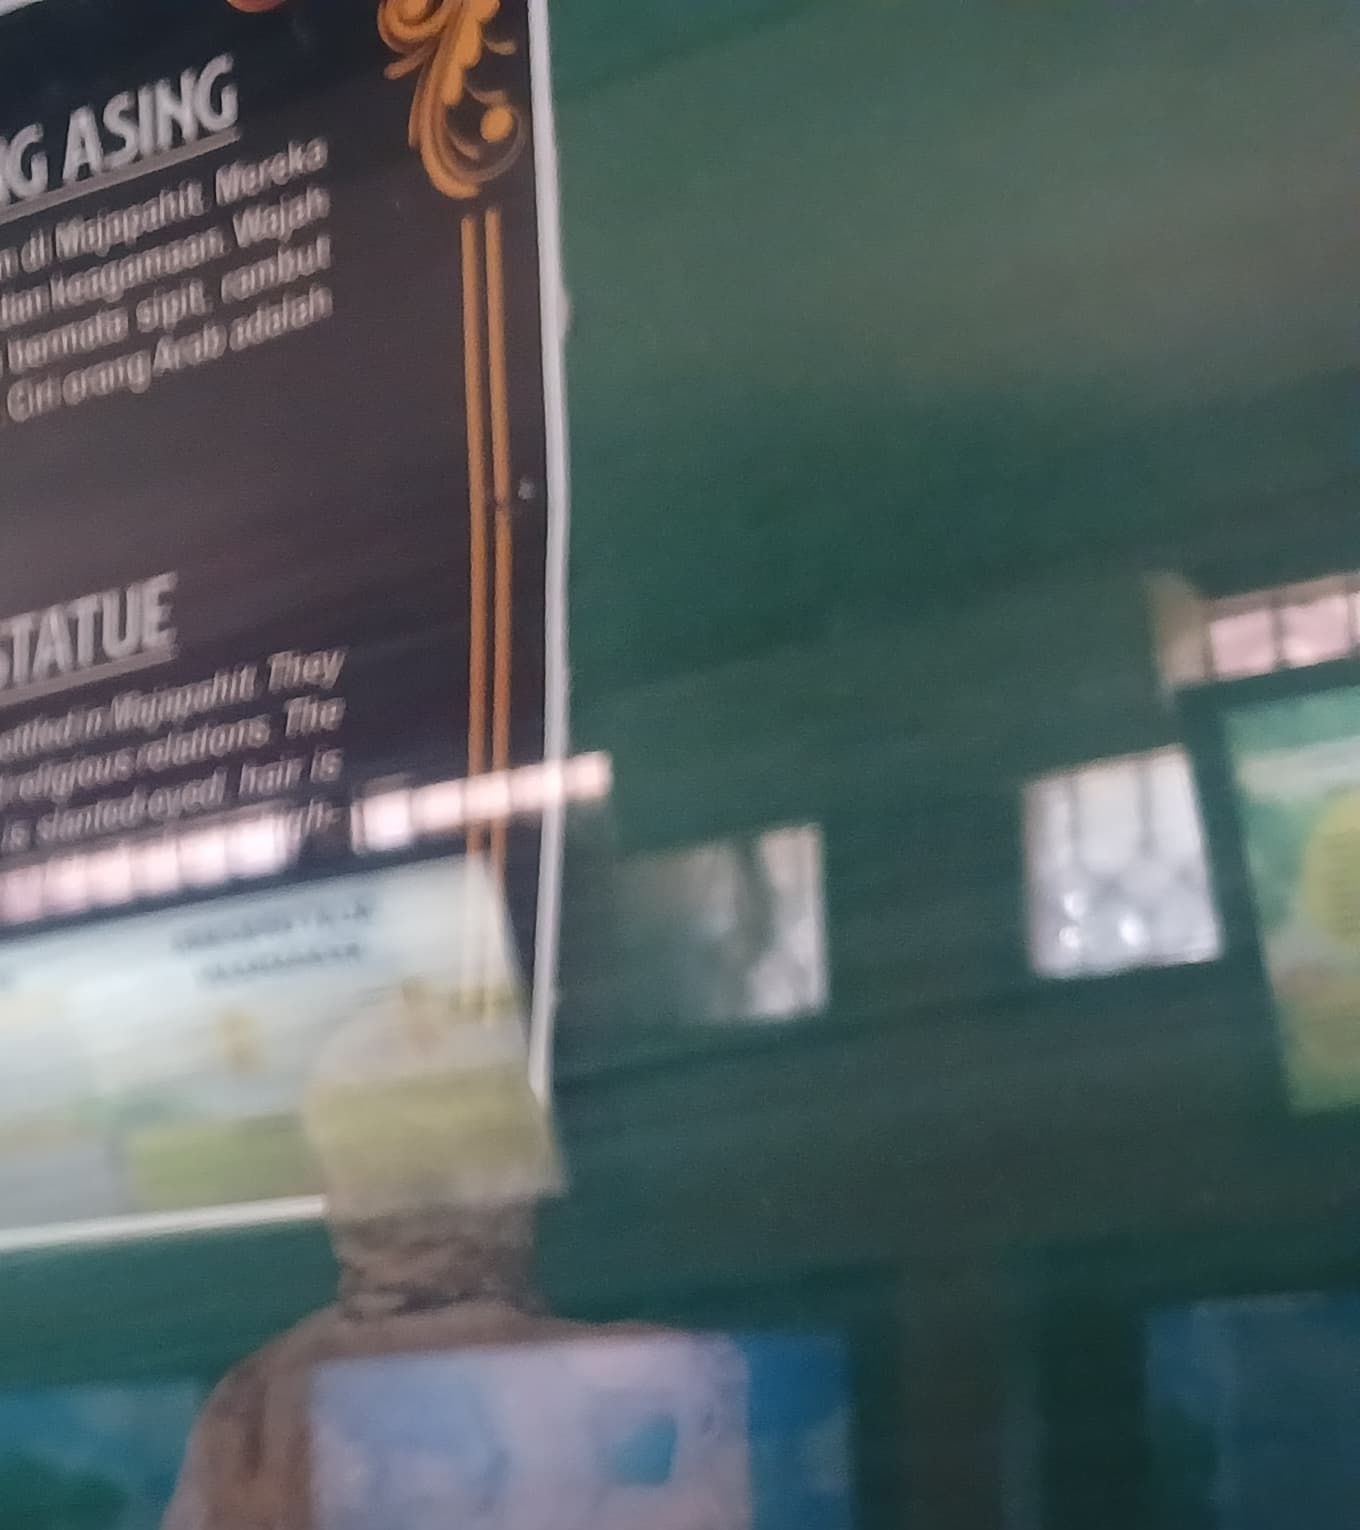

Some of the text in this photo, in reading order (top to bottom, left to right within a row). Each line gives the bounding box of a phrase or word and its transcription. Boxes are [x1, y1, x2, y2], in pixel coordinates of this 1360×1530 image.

[61, 51, 239, 183] ASING
[21, 228, 52, 273] di
[216, 136, 329, 206] Mereka
[233, 187, 330, 248] Wajah
[222, 235, 330, 303] rambut
[7, 378, 63, 422] Ciri
[63, 350, 151, 405] orang
[152, 323, 228, 376] Arab
[230, 284, 333, 350] adalah
[268, 648, 348, 691] They
[284, 695, 346, 736] The
[1, 819, 30, 855] is
[239, 757, 306, 797] hair
[311, 749, 344, 782] is
